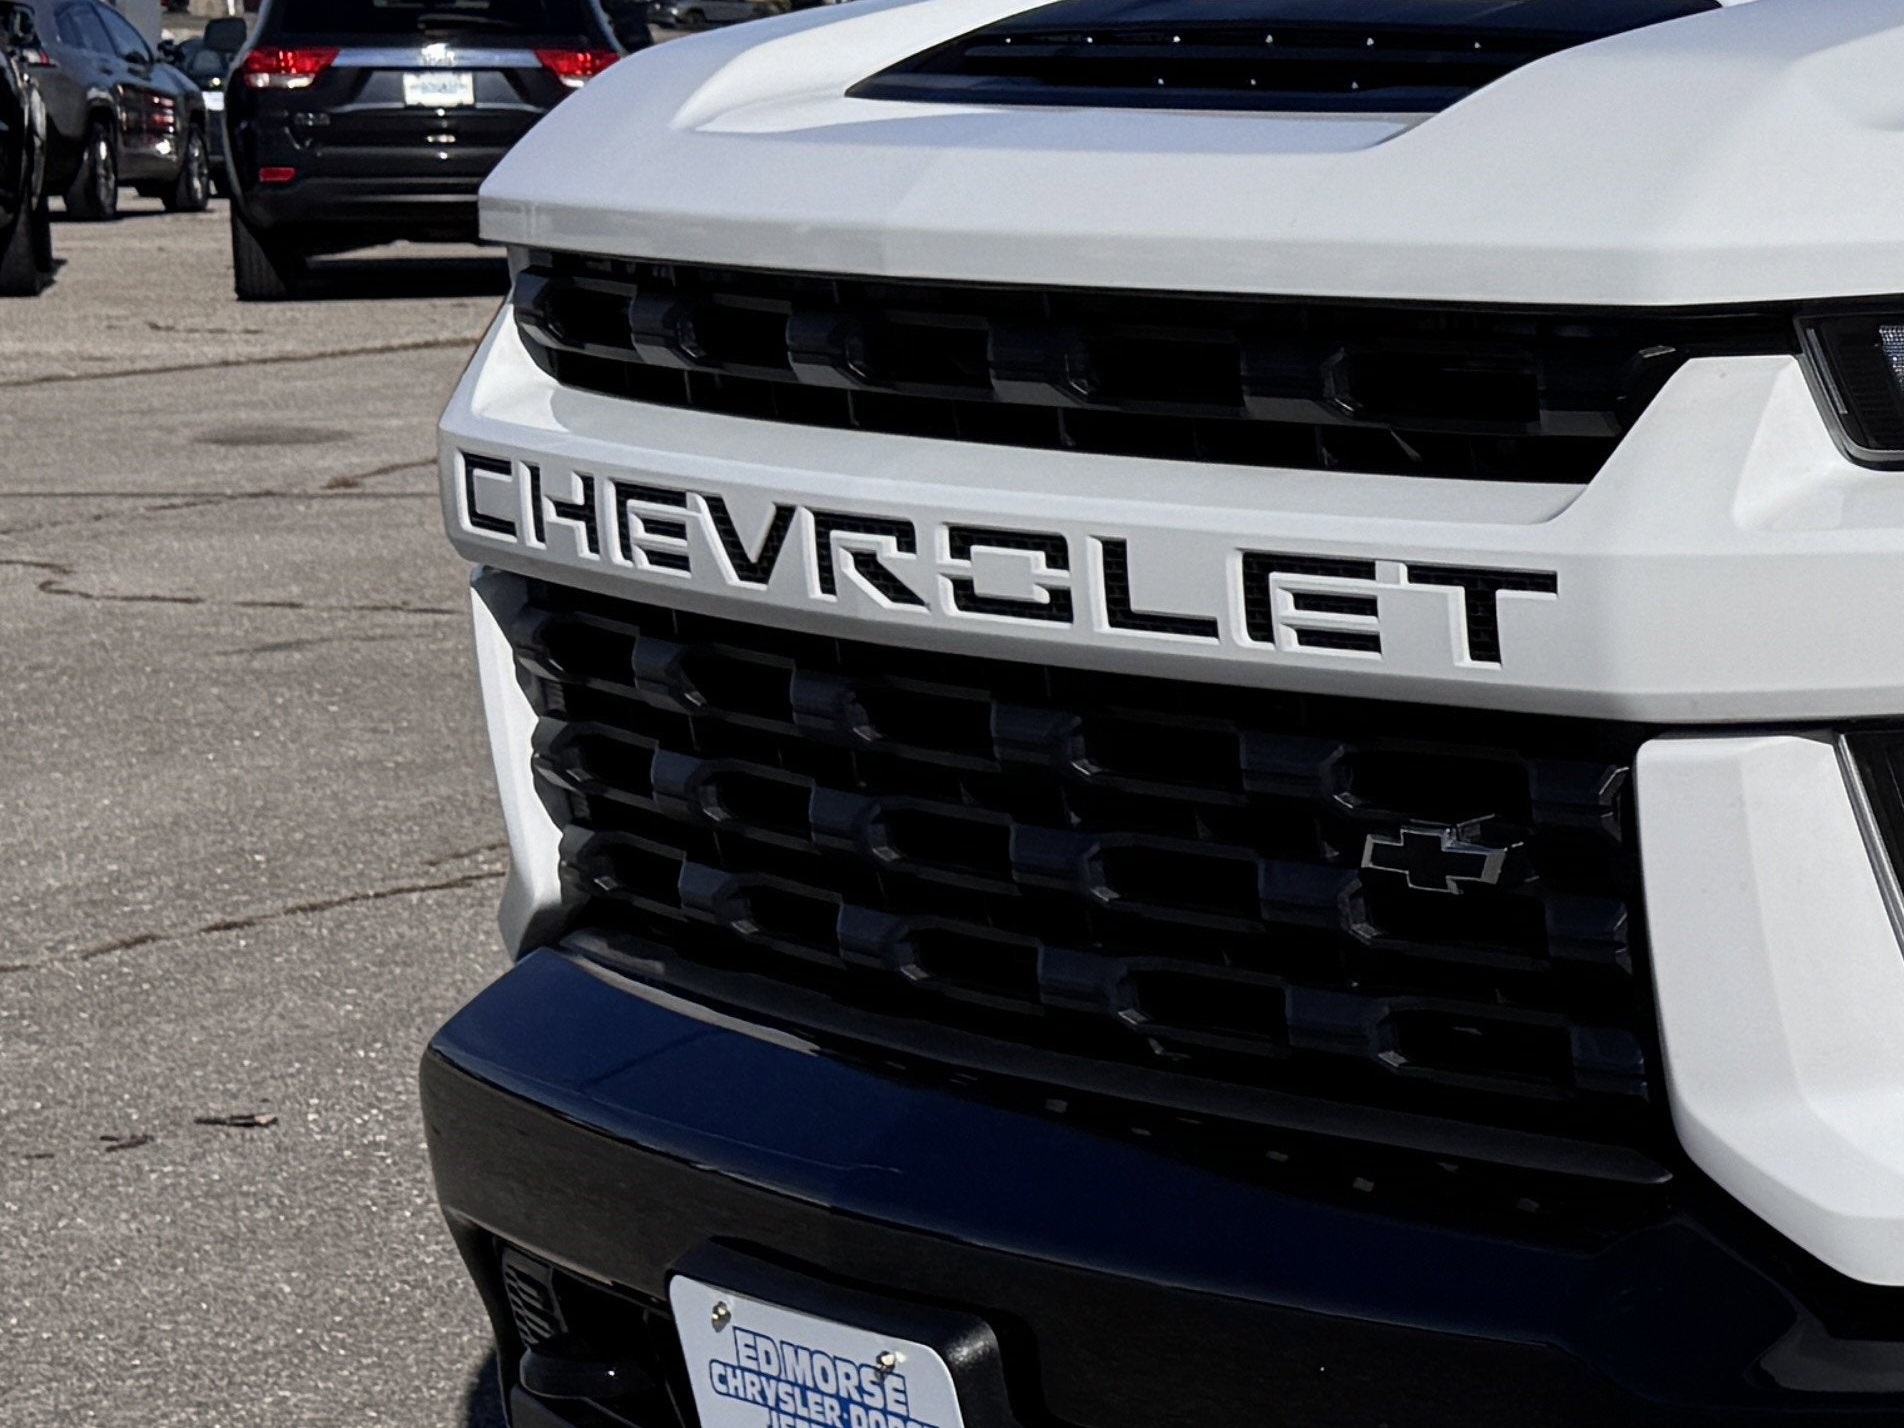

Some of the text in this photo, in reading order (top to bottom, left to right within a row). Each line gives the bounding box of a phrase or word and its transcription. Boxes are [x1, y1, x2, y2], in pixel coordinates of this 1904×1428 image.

[456, 448, 1559, 669] CHEVROLET
[733, 1326, 909, 1418] ED MORSE
